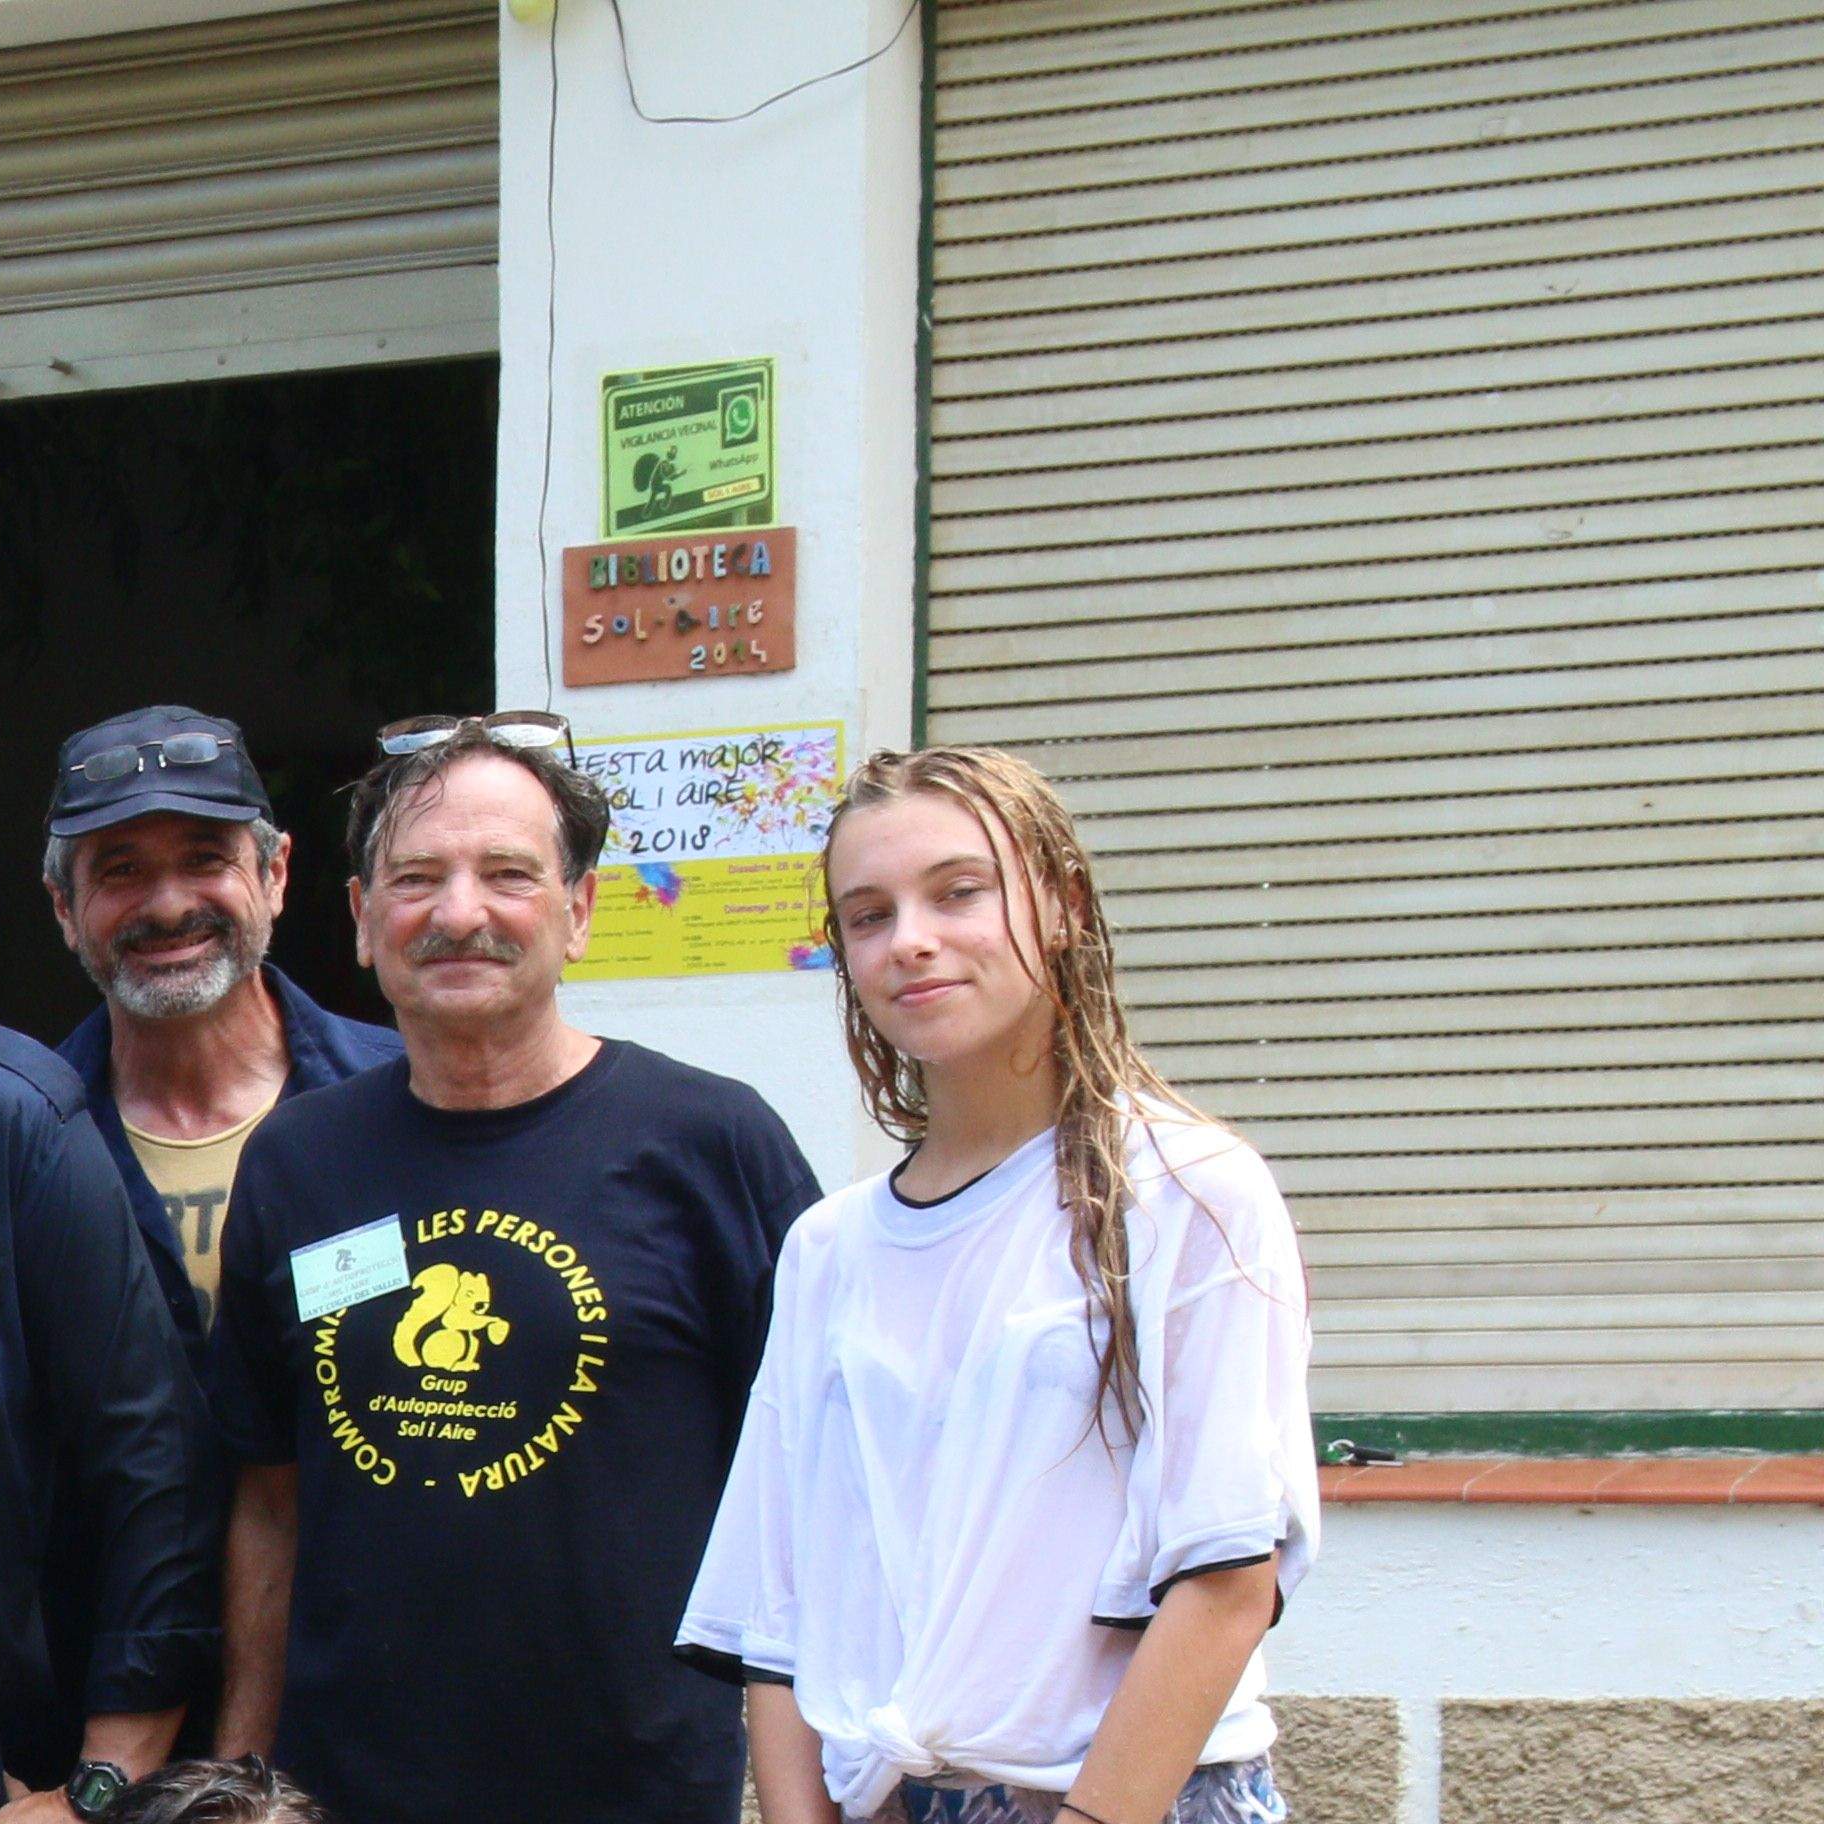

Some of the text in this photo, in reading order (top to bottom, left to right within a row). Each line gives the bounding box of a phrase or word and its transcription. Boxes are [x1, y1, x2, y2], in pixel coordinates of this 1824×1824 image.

[620, 393, 686, 420] ATENCIÓN
[590, 541, 772, 590] BIBLIOTECA
[629, 823, 712, 855] 2018
[416, 1208, 467, 1244] LES
[475, 1209, 607, 1323] PERSONES
[420, 1374, 469, 1395] Grup
[568, 1352, 605, 1393] LA
[368, 1394, 518, 1420] d'Autoprotecció
[397, 1420, 426, 1438] Sol
[437, 1421, 478, 1441] Aire
[457, 1401, 583, 1498] NATURA
